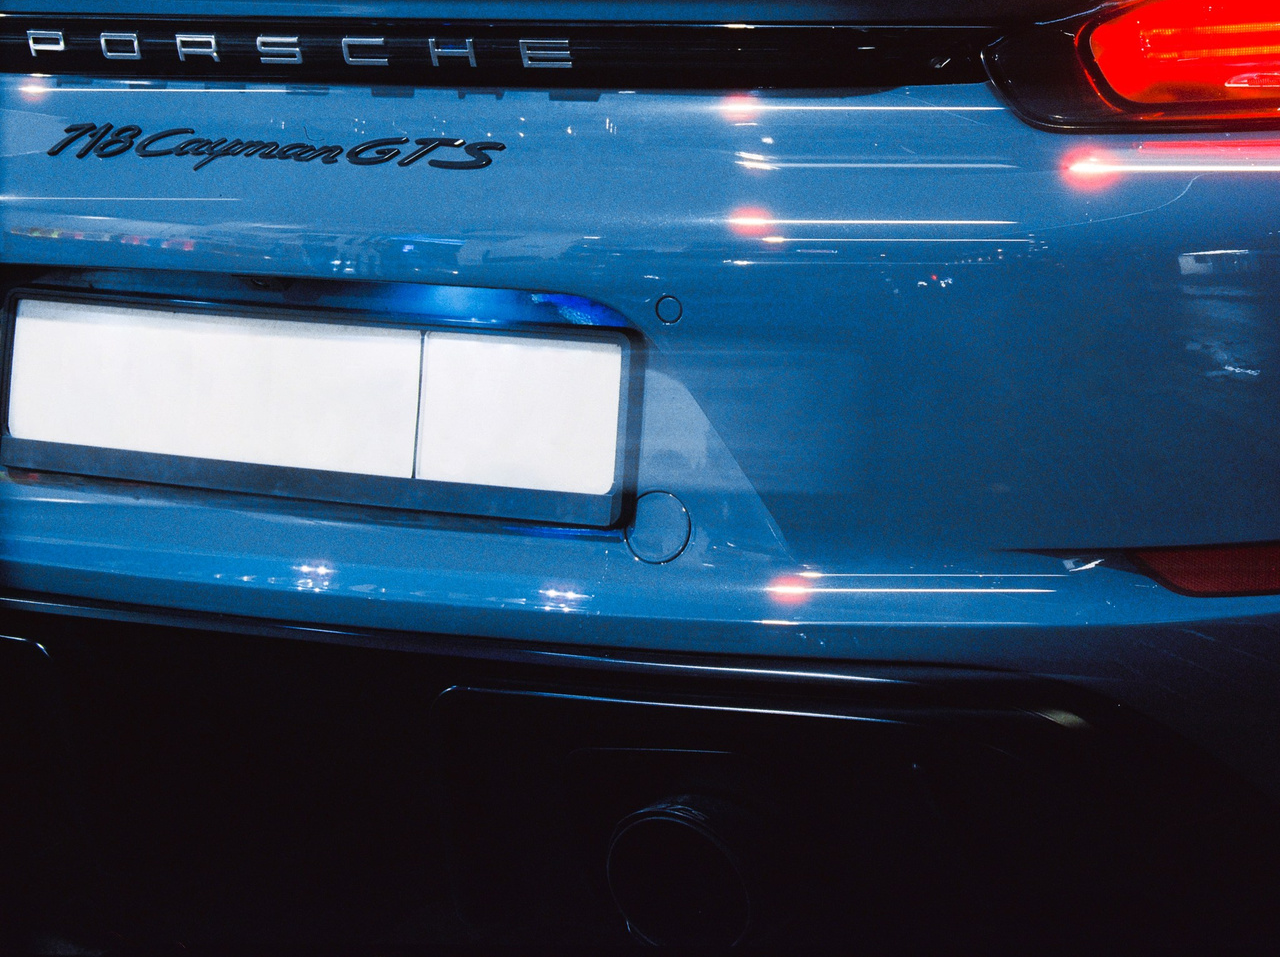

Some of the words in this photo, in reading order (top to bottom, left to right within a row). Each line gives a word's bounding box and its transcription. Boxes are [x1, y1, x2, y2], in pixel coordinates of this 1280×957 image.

[26, 30, 572, 68] PORSCHE
[47, 122, 142, 159] 718
[135, 128, 344, 171] Cayman
[346, 136, 506, 170] GTS
